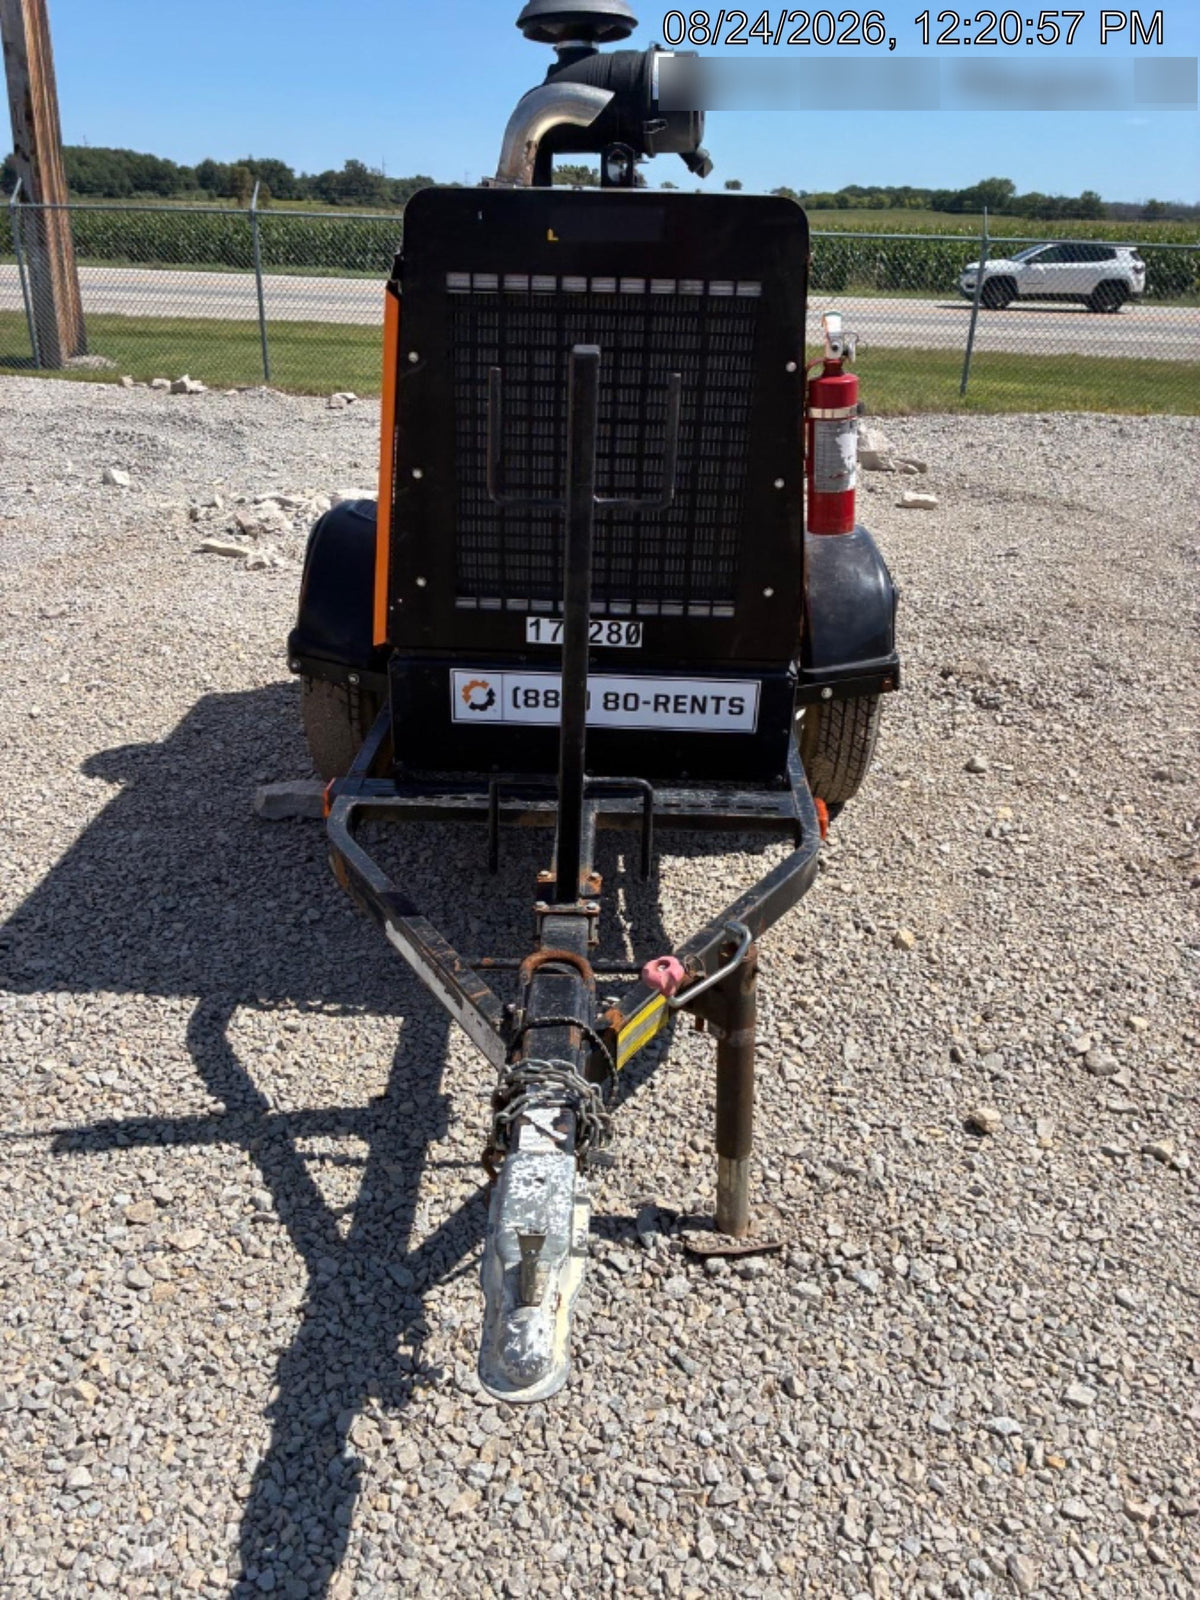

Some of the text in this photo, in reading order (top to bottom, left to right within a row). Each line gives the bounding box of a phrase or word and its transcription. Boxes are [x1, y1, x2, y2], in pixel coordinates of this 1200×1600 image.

[529, 618, 641, 645] 17280
[512, 686, 746, 716] (88) 80-RENTS
